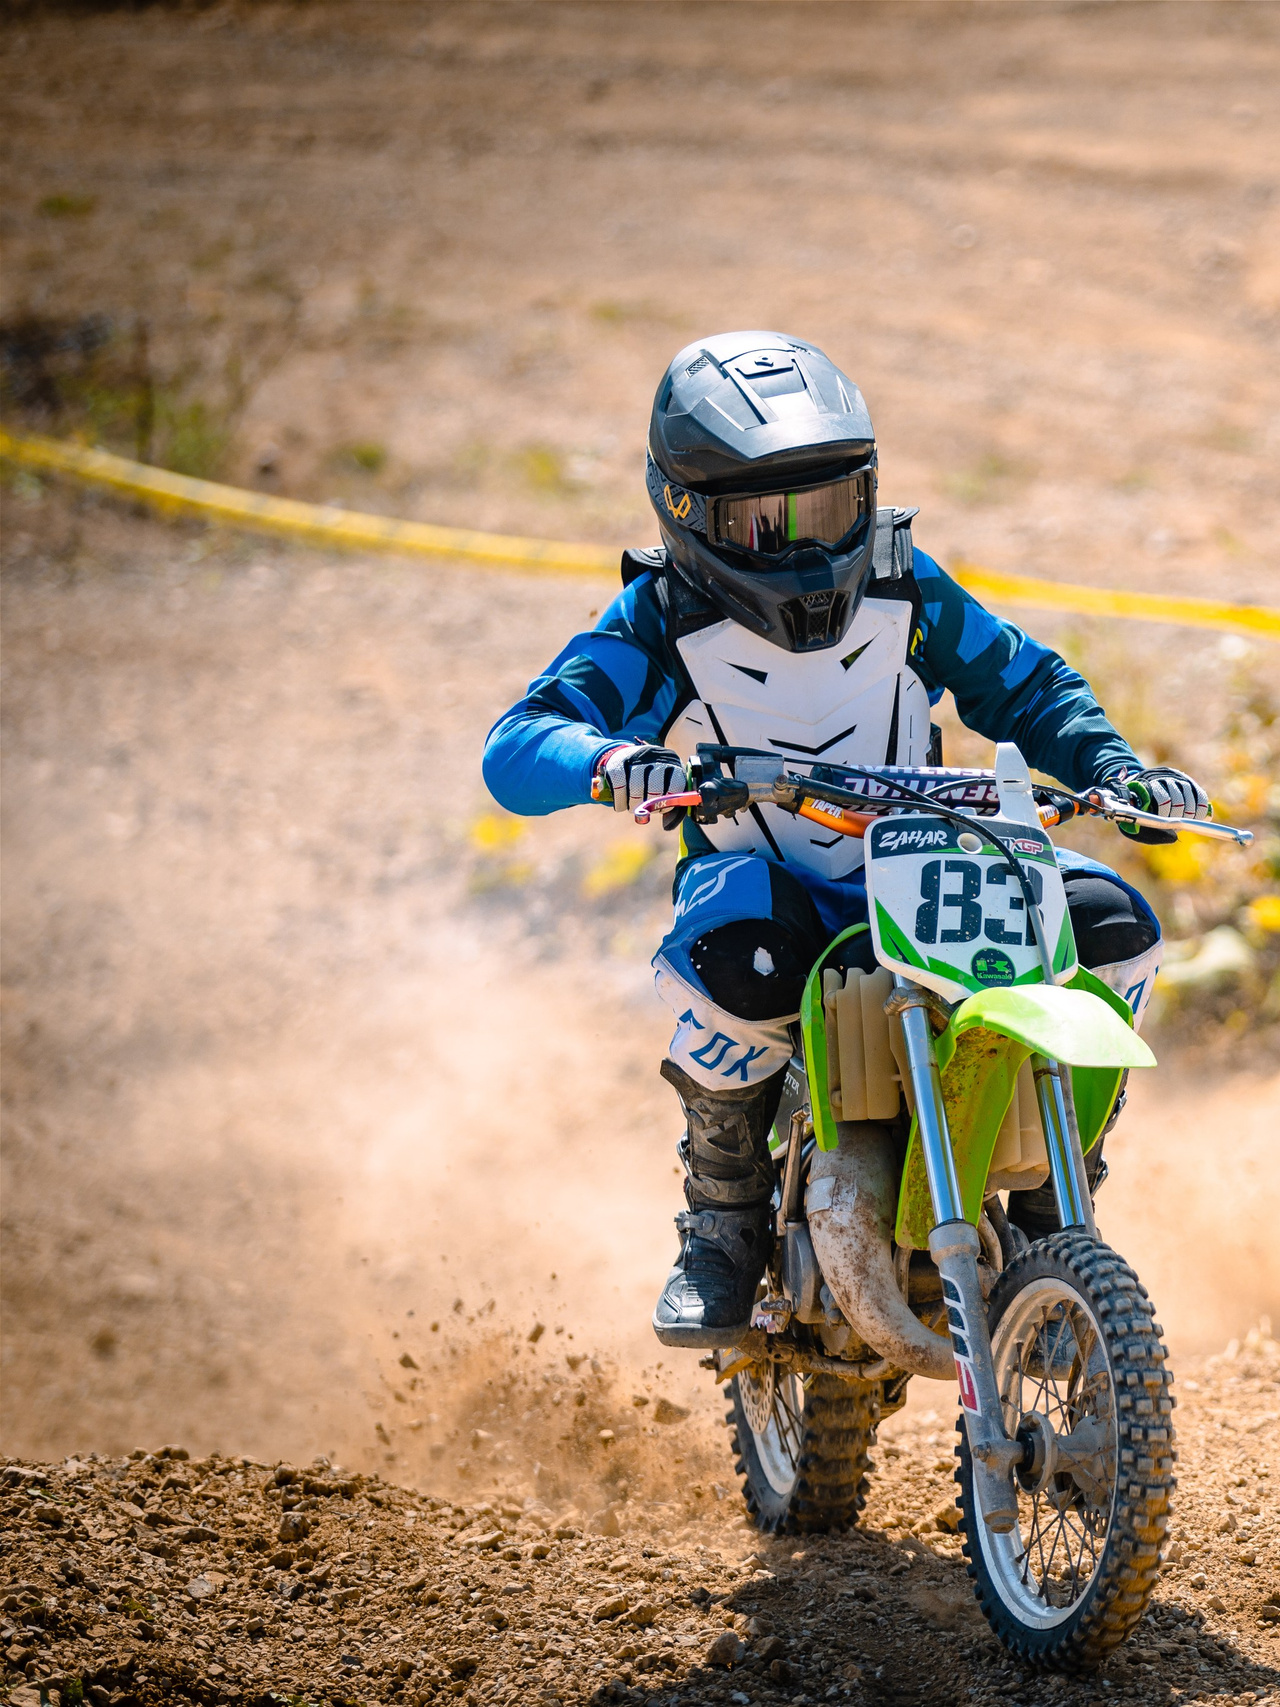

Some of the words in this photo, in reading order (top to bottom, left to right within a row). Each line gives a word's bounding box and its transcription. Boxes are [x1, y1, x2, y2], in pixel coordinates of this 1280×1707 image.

[811, 798, 844, 819] TAPER
[878, 830, 948, 851] ZAHAR
[915, 859, 1044, 947] 83
